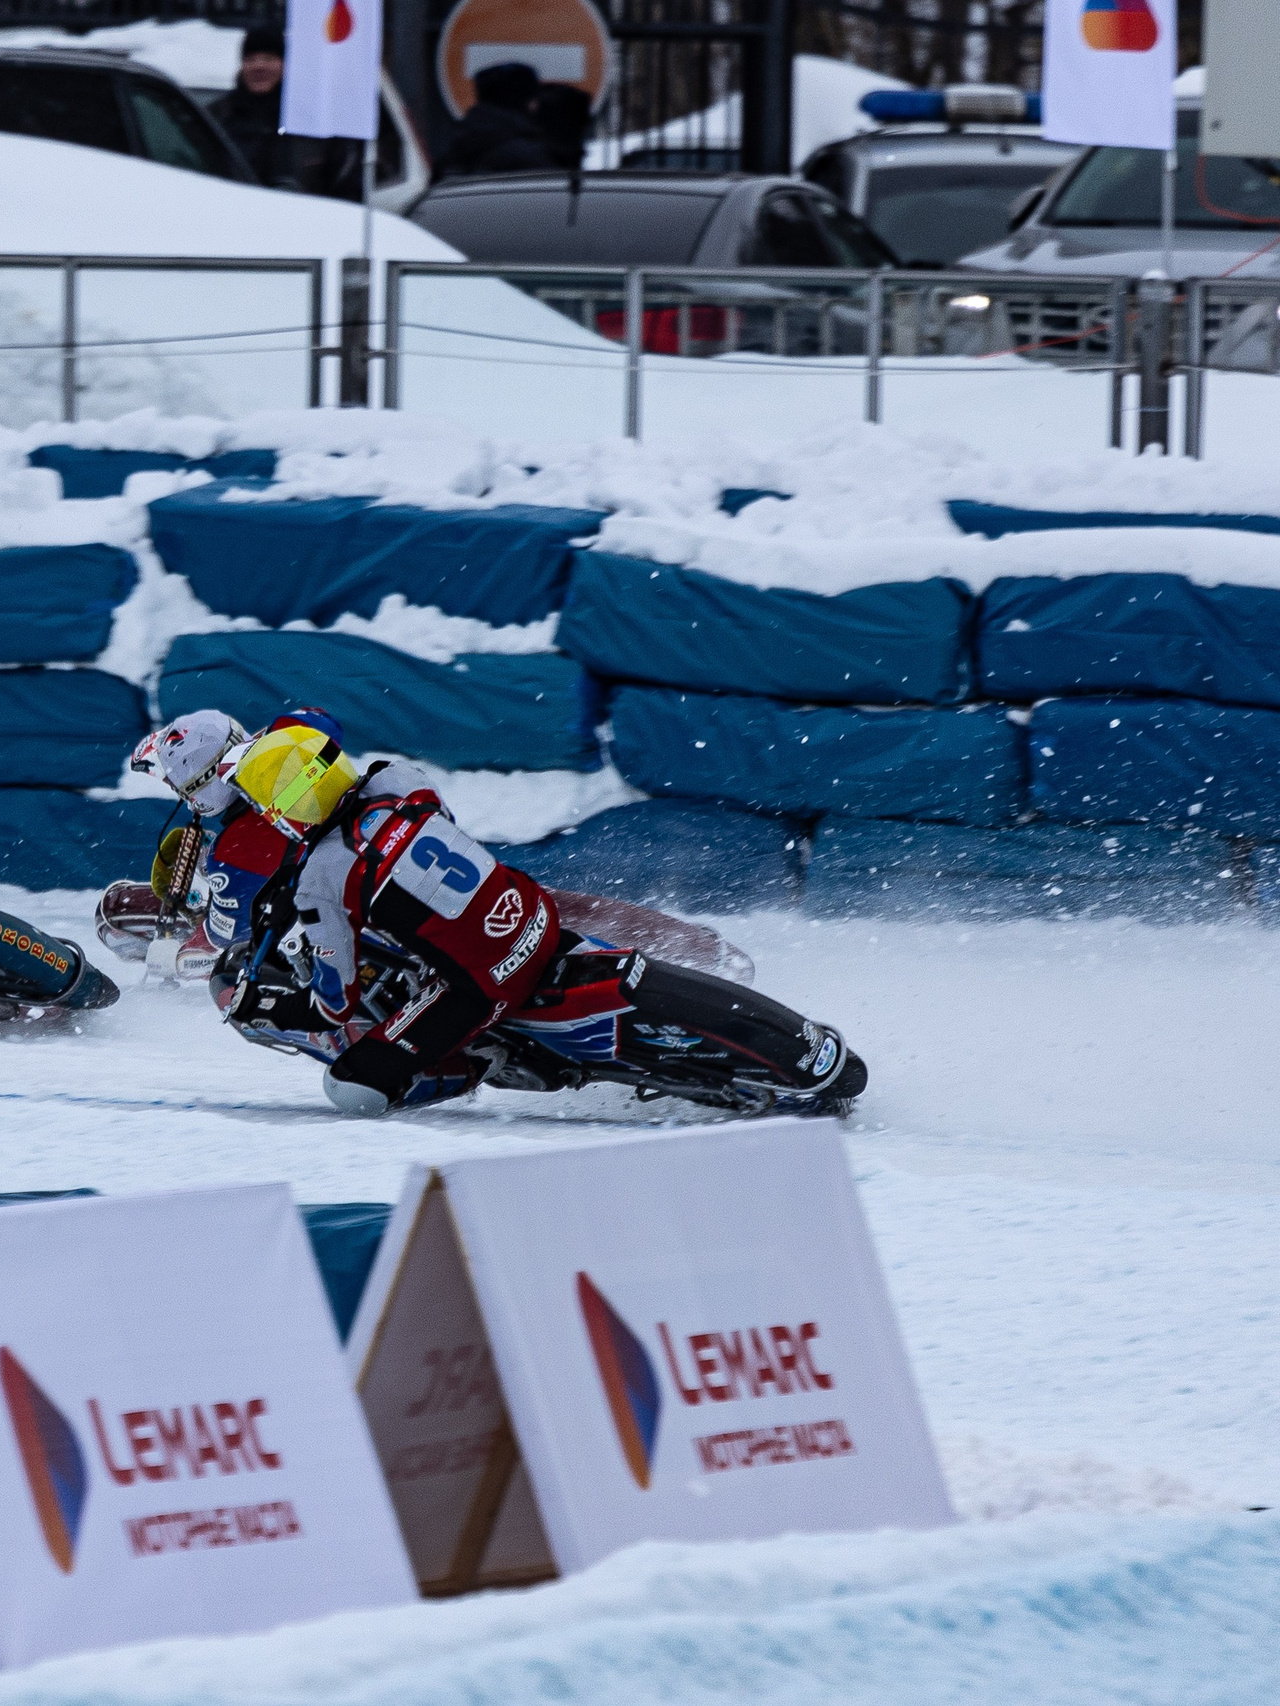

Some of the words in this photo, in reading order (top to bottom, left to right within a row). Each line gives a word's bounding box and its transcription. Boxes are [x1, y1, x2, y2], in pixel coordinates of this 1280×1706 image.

[185, 759, 221, 795] SCO
[409, 836, 481, 894] 3
[656, 1322, 836, 1406] LEMARC
[89, 1399, 283, 1486] LEMARC
